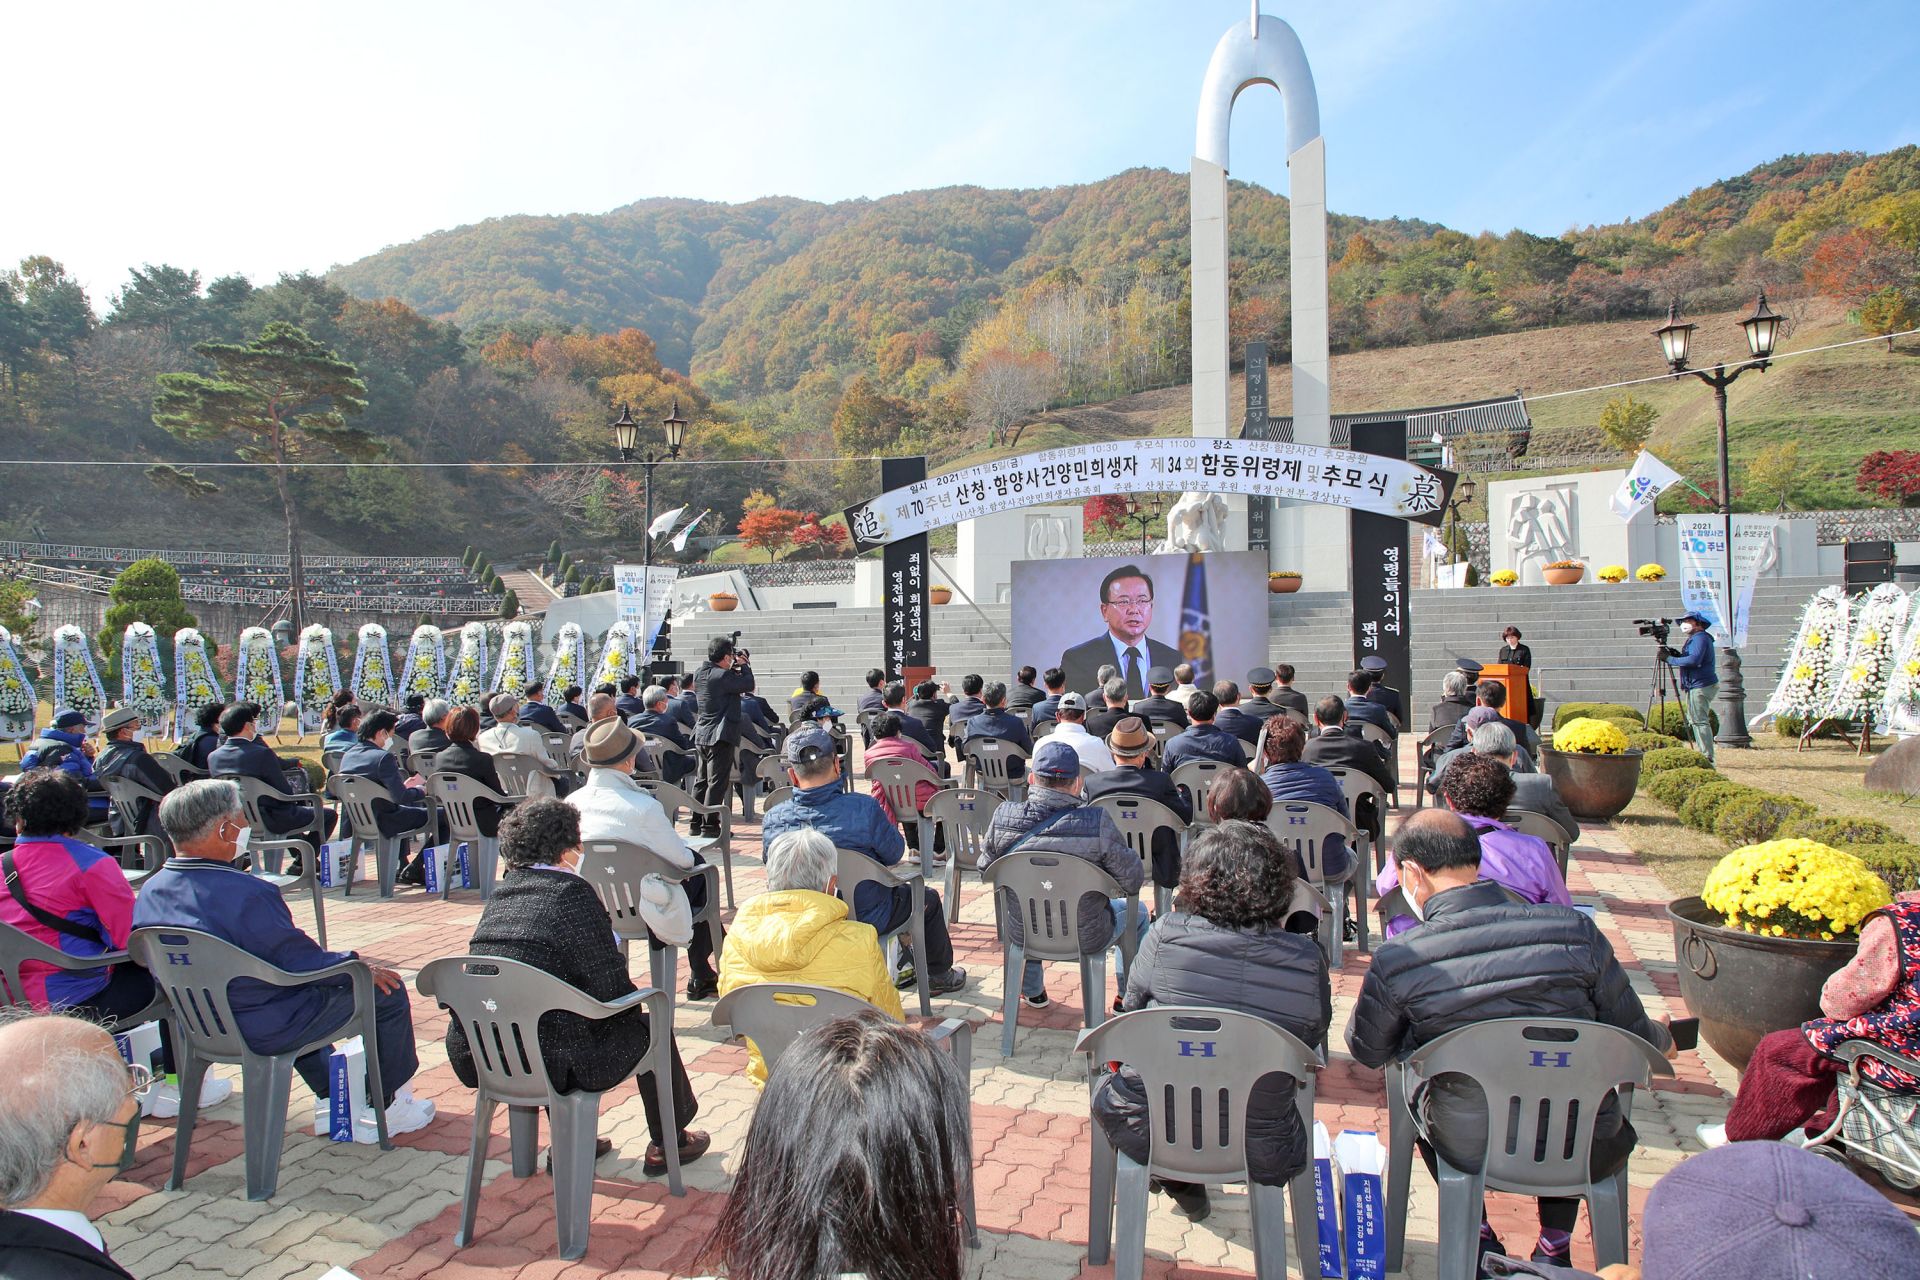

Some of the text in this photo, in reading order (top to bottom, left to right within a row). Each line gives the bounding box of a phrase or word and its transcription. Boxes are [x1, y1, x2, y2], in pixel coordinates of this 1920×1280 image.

[909, 482, 928, 494] 일시
[936, 470, 969, 486] 2021년
[1038, 446, 1087, 463] 합동위령제
[1091, 444, 1118, 453] 10:30
[1133, 440, 1164, 450] 추모식
[1170, 440, 1196, 448] 11:00
[1212, 440, 1233, 450] 장소
[1323, 449, 1368, 465] 추모공원
[895, 453, 1388, 520] 제70주년 산청·함양사건양민희생자 제34회 합동위령제 및 추모식
[1402, 473, 1441, 512] 慕
[923, 517, 941, 529] 주최
[1113, 482, 1133, 492] 주관
[1218, 481, 1238, 491] 후원
[854, 506, 887, 542] 追
[891, 570, 904, 607] 영전에
[1383, 546, 1401, 636] 영령들이시여
[892, 611, 905, 635] 삼가
[909, 593, 922, 641] 희생되신
[1361, 620, 1378, 651] 편히
[892, 639, 905, 676] 명복을
[1121, 811, 1138, 819] H
[1288, 816, 1307, 825] H
[167, 952, 192, 966] H
[1177, 1041, 1217, 1057] H
[1529, 1050, 1572, 1067] H
[1363, 1180, 1372, 1202] 지리산
[1366, 1221, 1374, 1235] 여행
[1357, 1240, 1365, 1255] 여행
